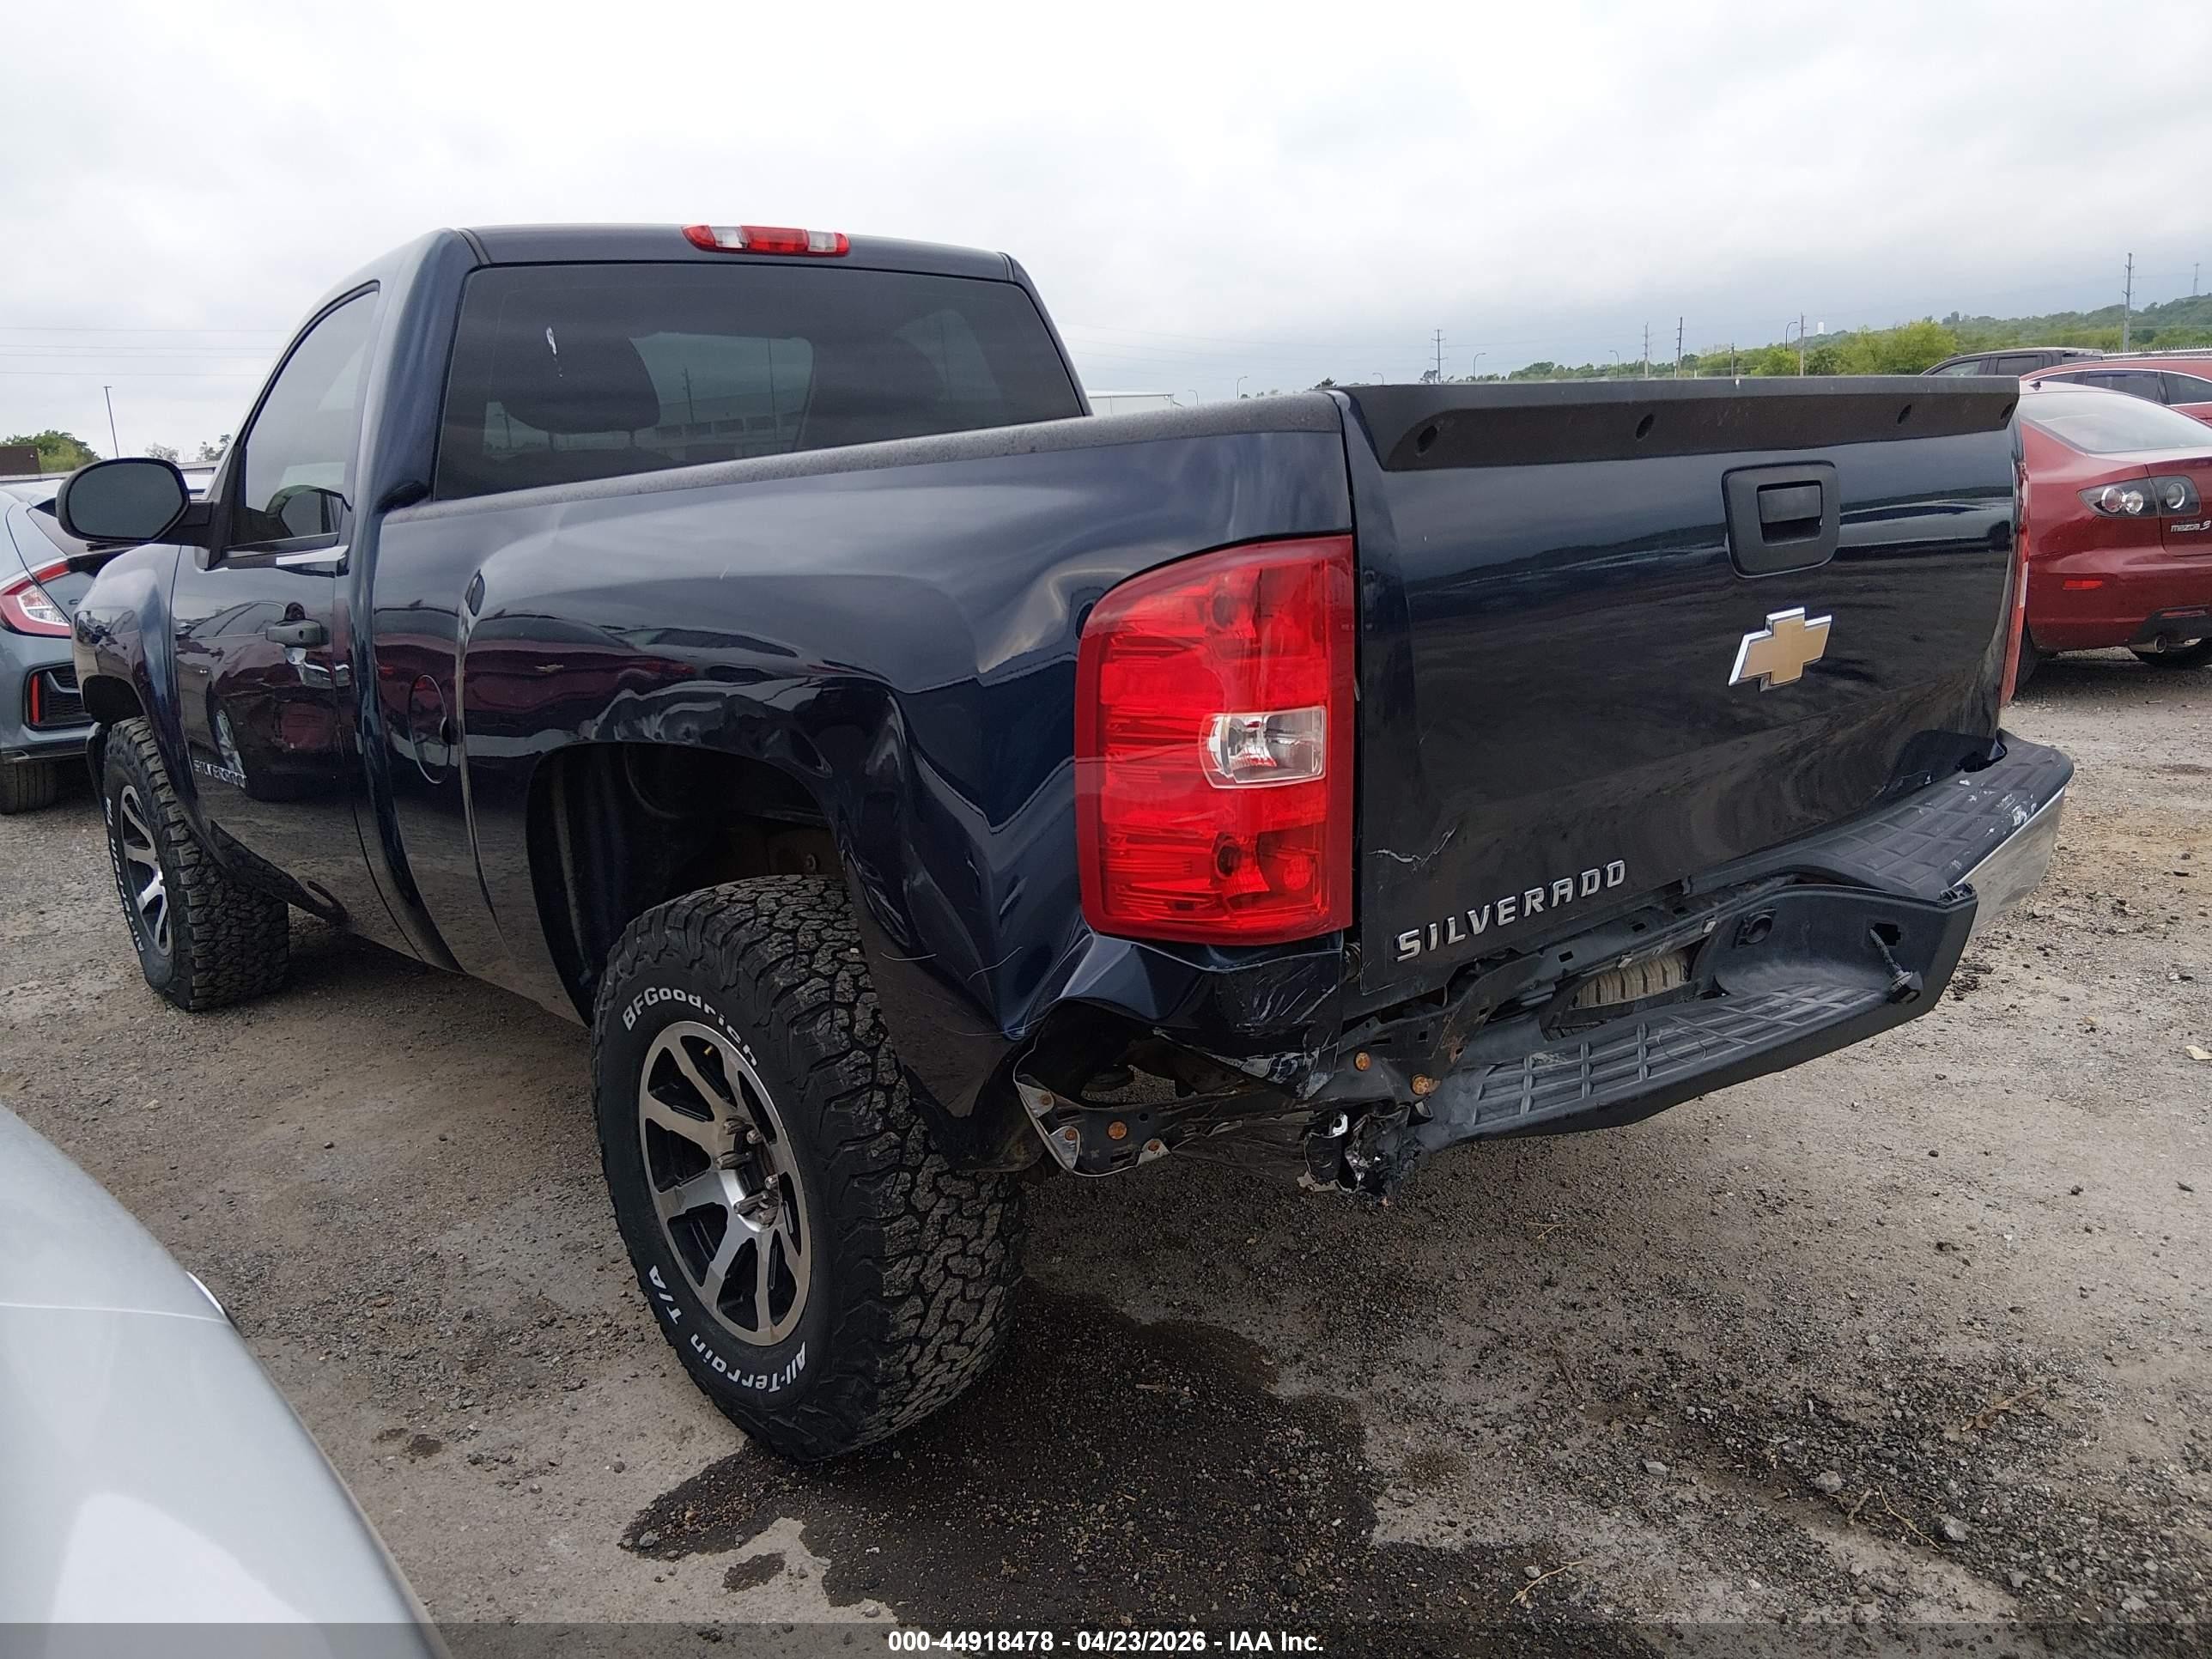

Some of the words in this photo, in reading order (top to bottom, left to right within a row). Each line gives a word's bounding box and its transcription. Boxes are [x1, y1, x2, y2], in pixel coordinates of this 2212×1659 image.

[1394, 860, 1626, 962] SILVERADO
[622, 987, 757, 1067] BFGoodrich
[648, 1265, 683, 1325] T/A
[690, 1334, 806, 1393] All-Terrain
